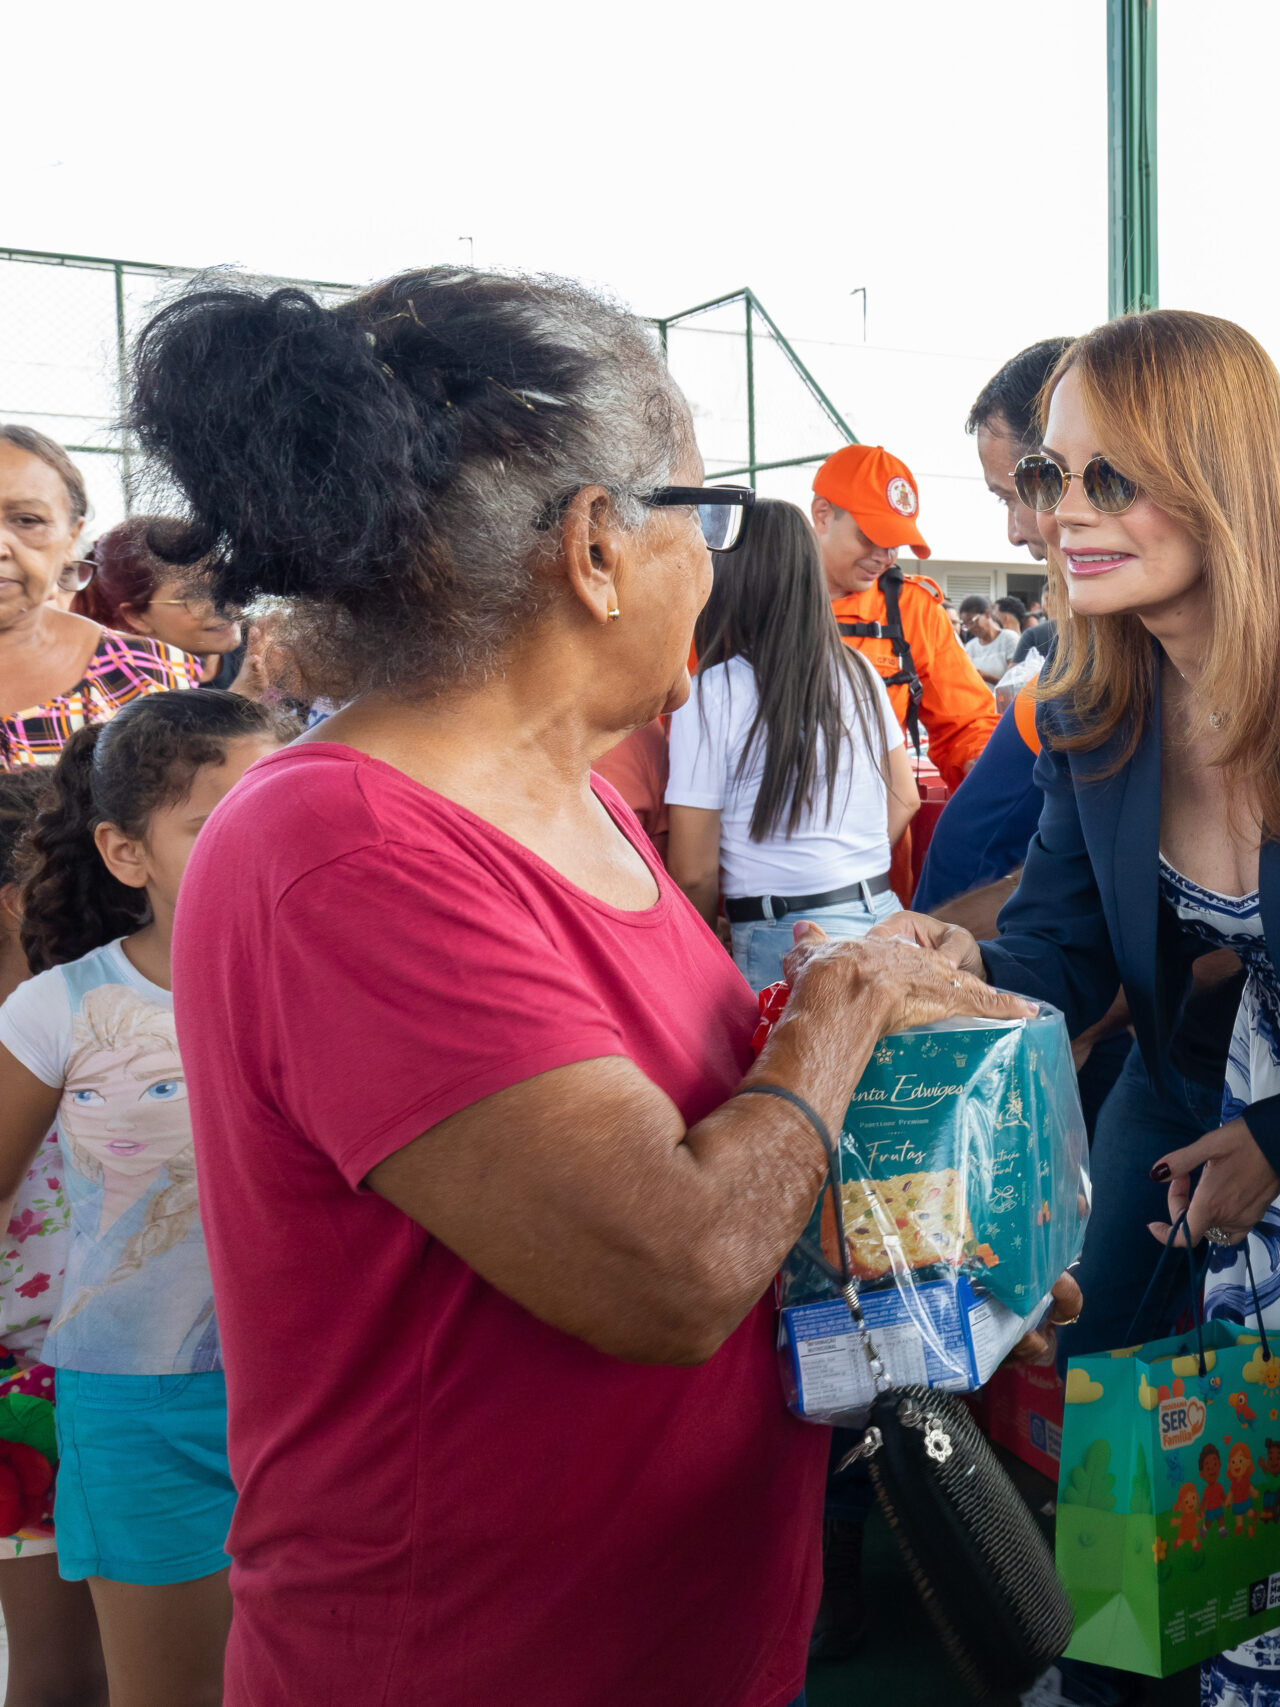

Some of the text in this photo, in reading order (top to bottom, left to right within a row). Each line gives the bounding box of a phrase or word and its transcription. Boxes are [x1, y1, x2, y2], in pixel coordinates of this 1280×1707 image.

[891, 1073, 966, 1104] Edwiges
[866, 1140, 927, 1172] Frutas
[1161, 1409, 1188, 1433] SER
[1163, 1429, 1193, 1447] Família
